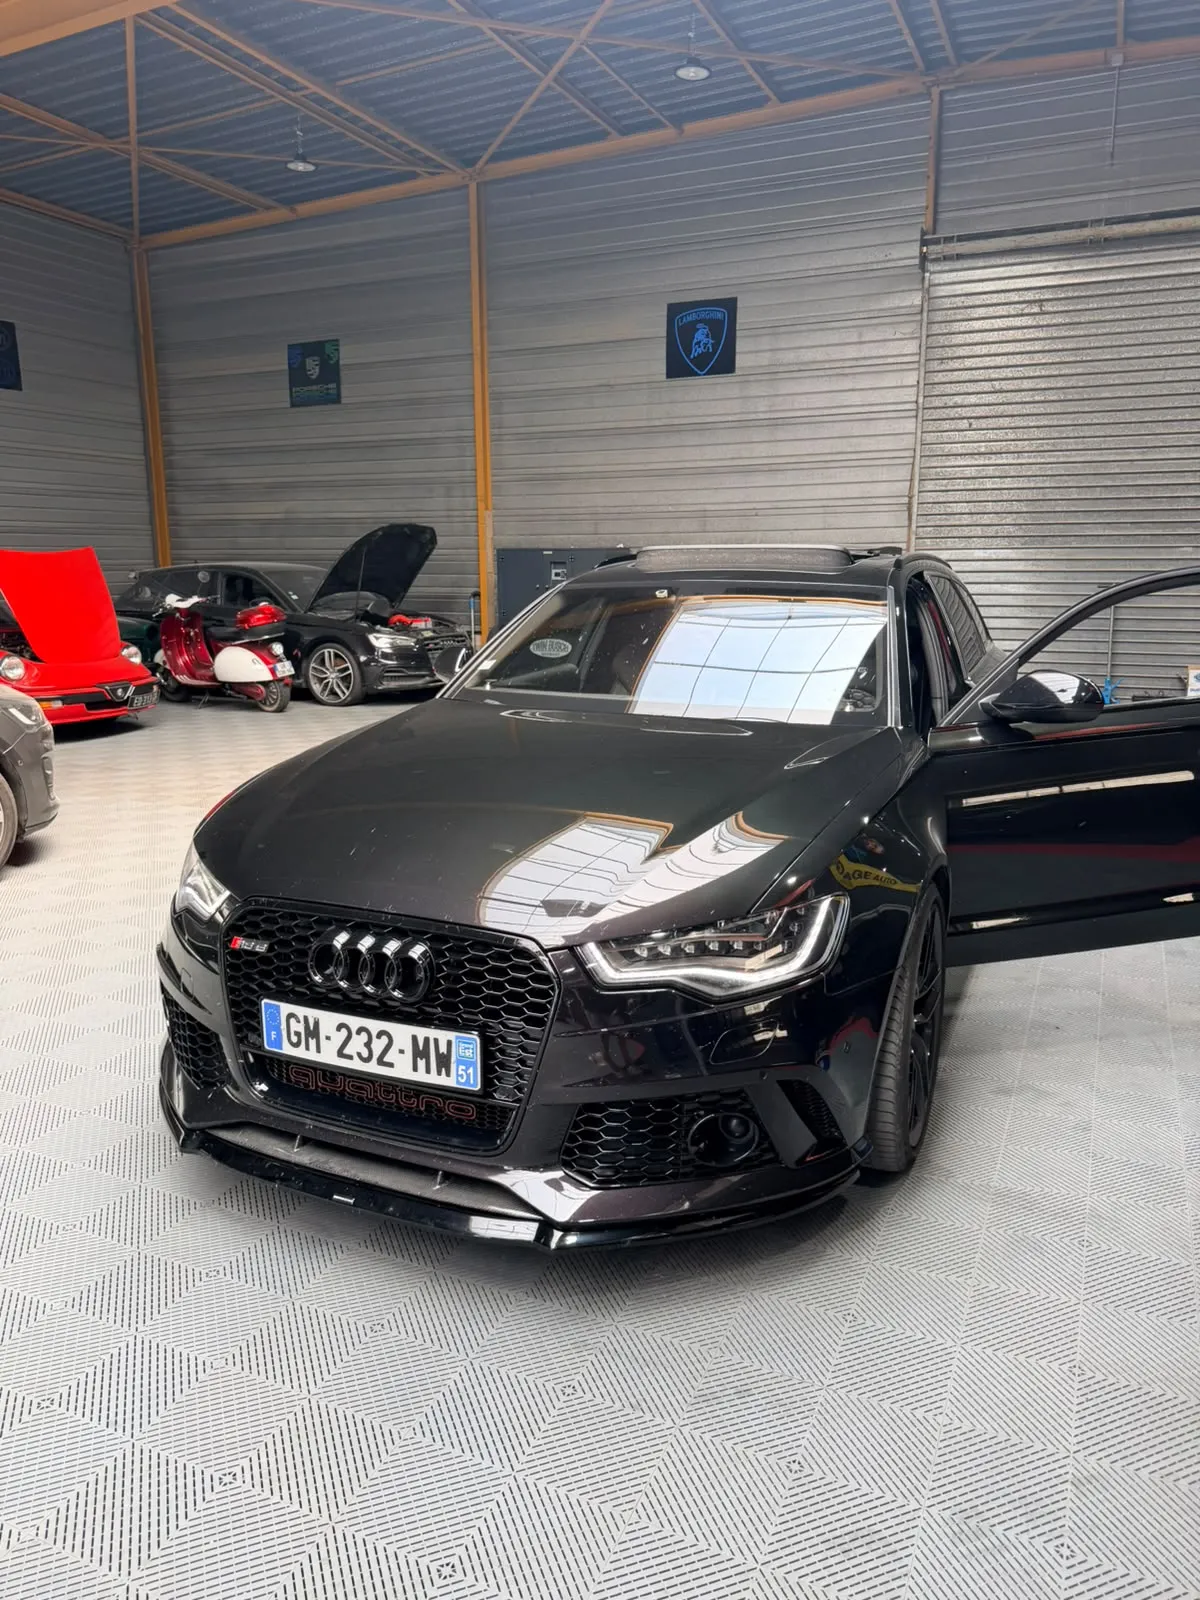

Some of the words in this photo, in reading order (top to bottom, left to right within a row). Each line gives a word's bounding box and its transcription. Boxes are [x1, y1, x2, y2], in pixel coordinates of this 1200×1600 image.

[678, 310, 724, 326] LAMBORGHINI
[873, 873, 897, 885] AUTO
[271, 1031, 277, 1041] F
[285, 1011, 453, 1078] GM-232-MW
[457, 1064, 475, 1085] 51
[289, 1065, 476, 1119] quattro
